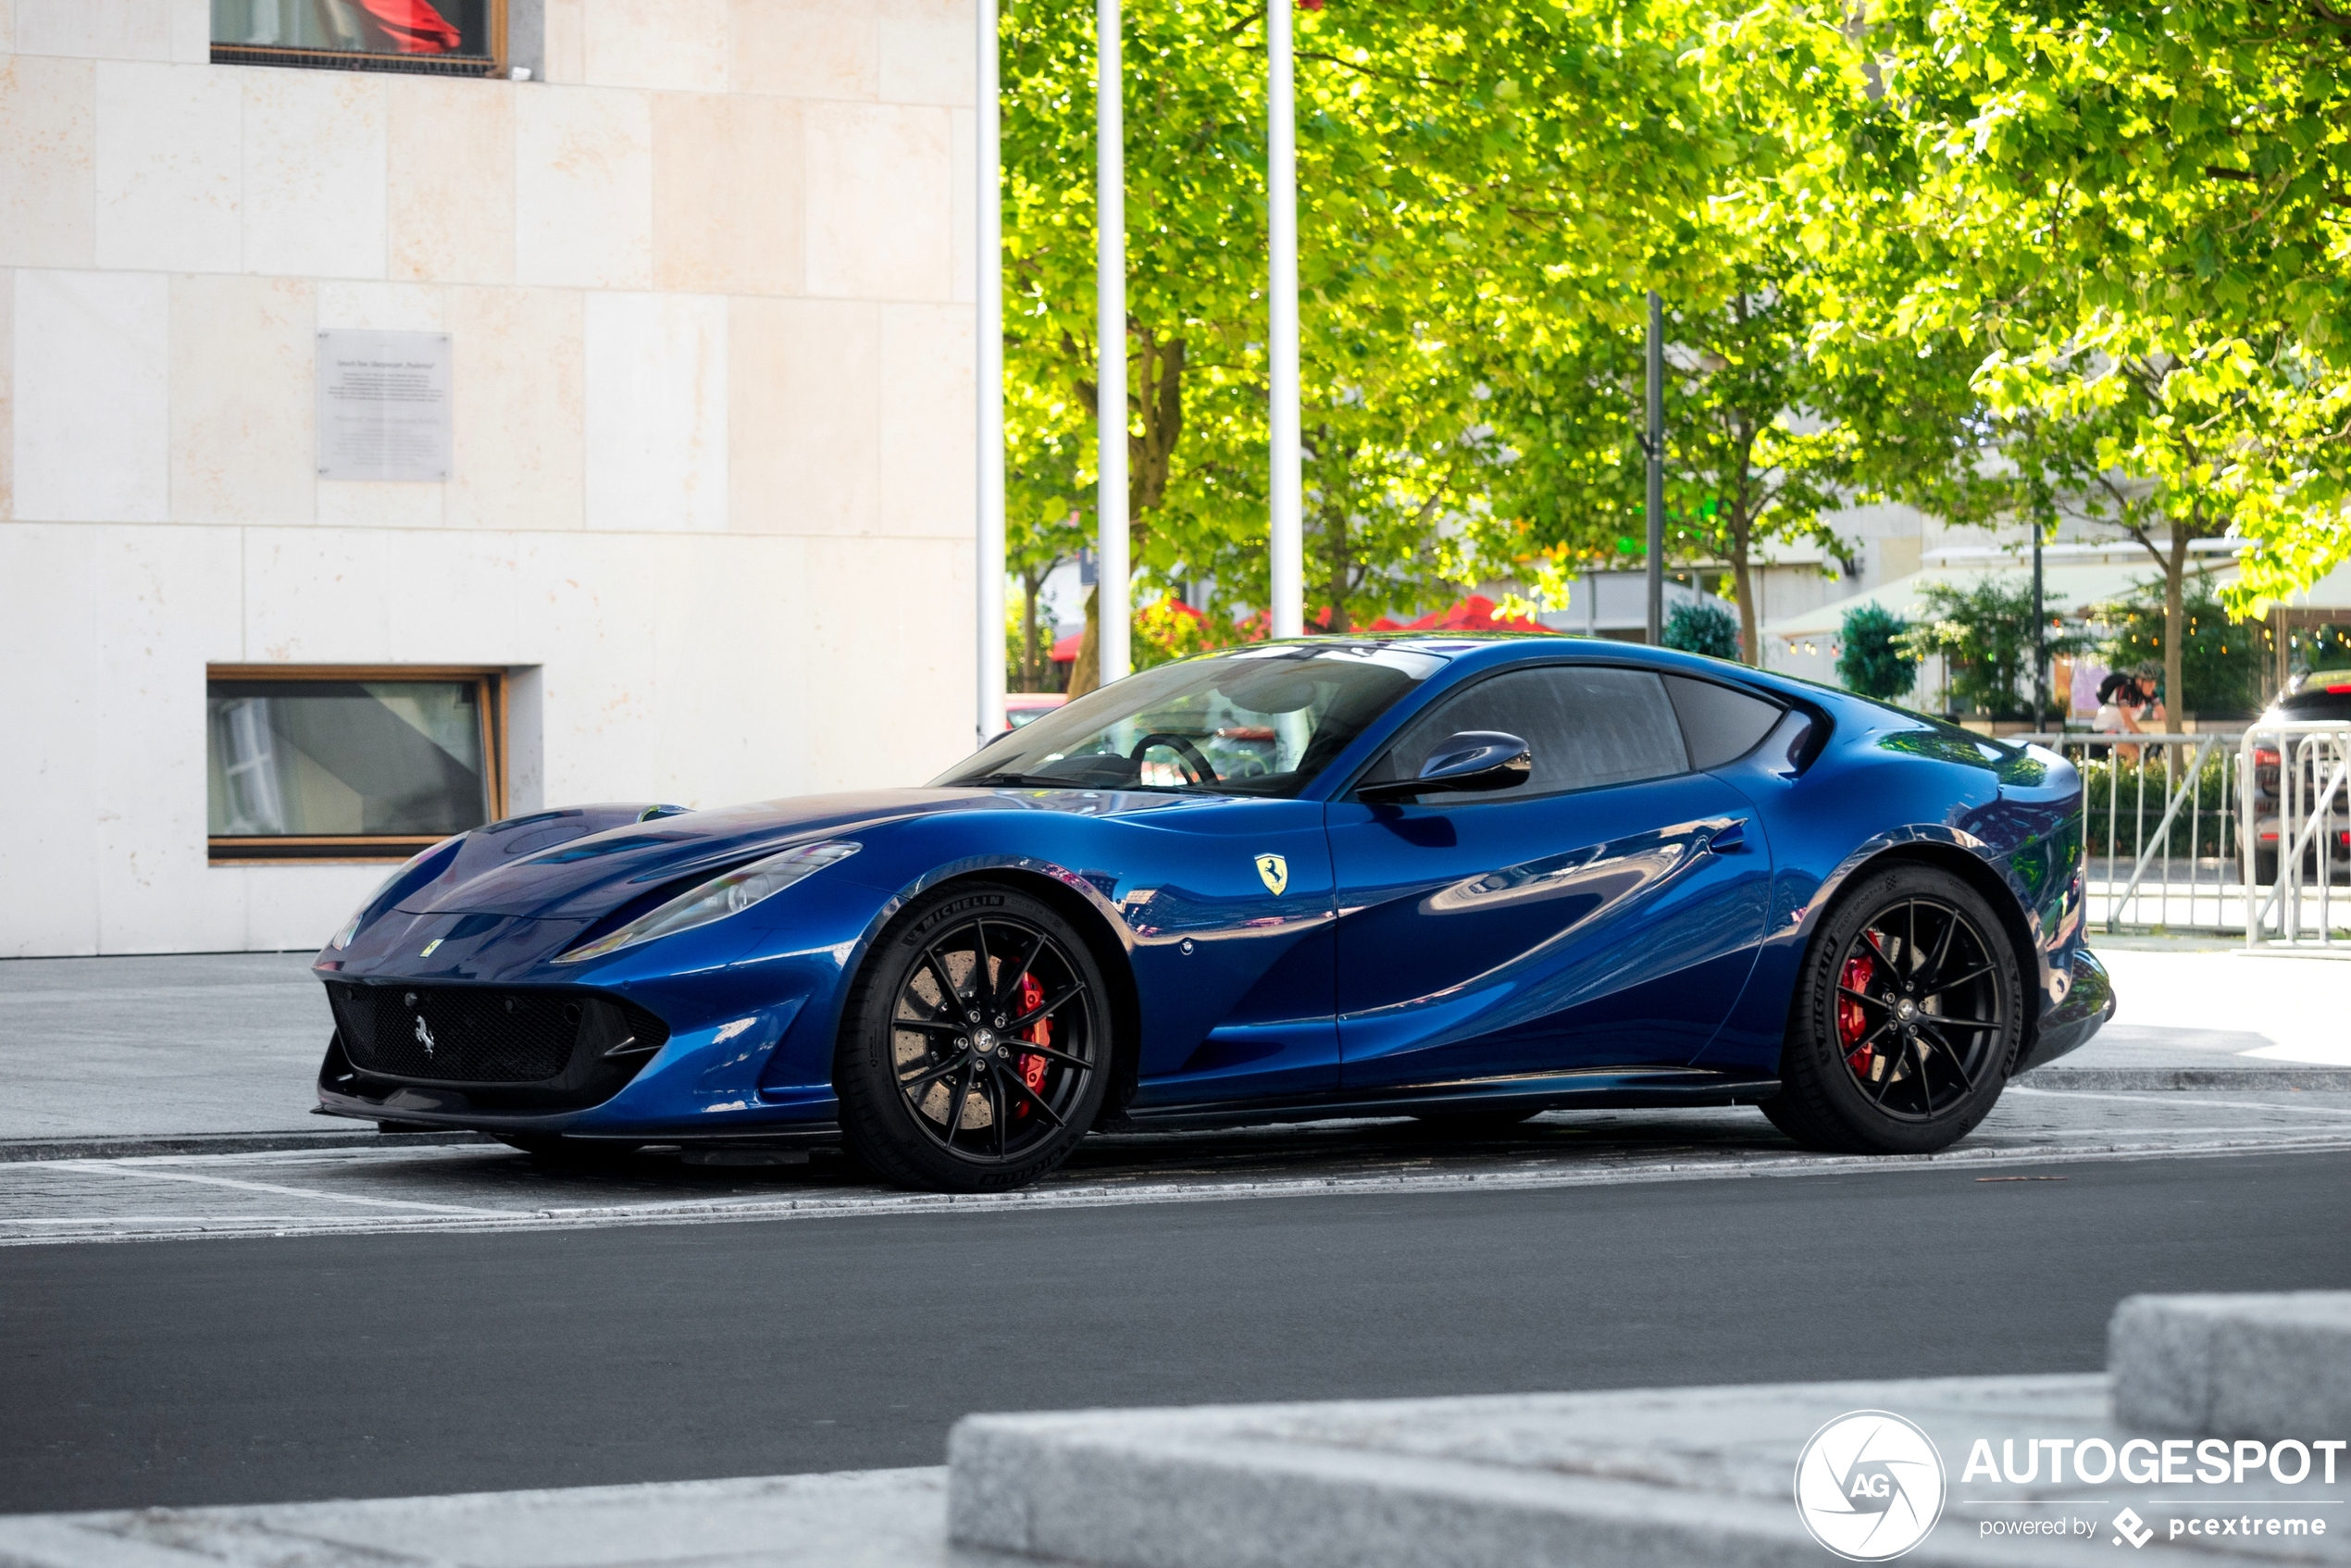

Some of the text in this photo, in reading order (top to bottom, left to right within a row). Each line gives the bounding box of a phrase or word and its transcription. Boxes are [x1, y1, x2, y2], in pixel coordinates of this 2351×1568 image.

[923, 895, 1001, 929] MICHELIN
[1836, 911, 1852, 934] PILOT
[1853, 890, 1874, 913] SPORT
[1814, 938, 1836, 1039] MICHELIN
[985, 1149, 1063, 1186] MICHELIN
